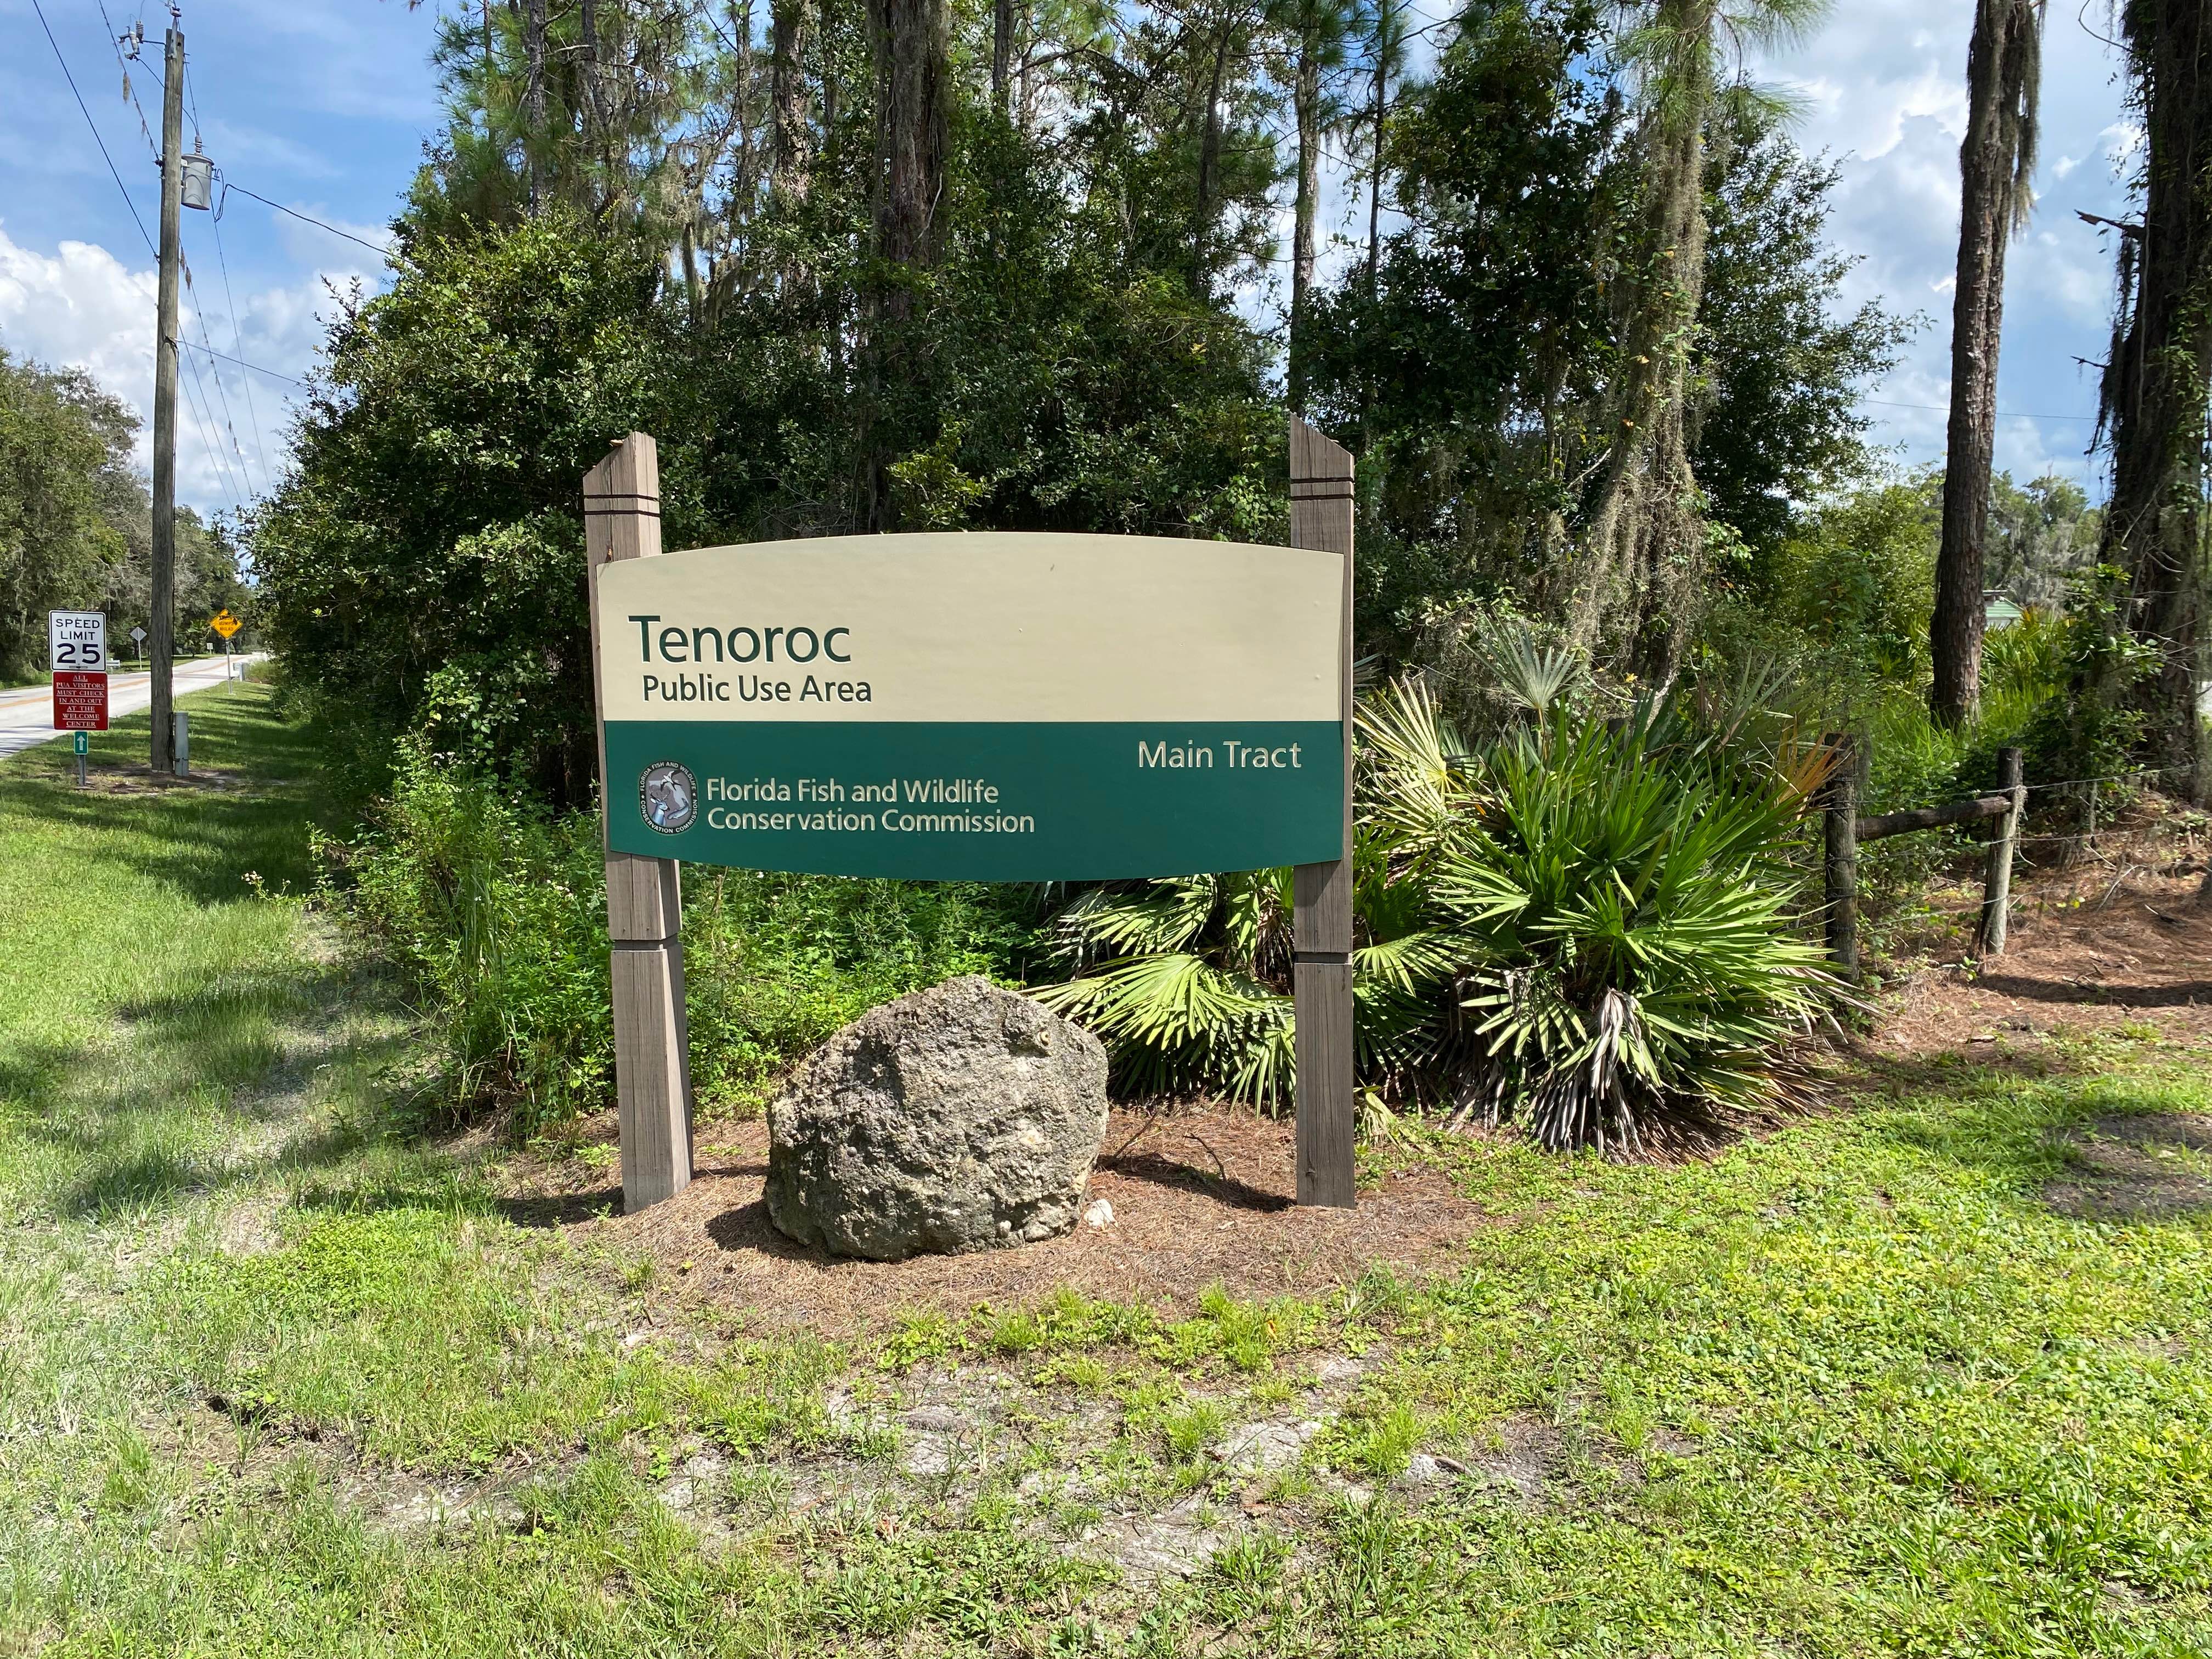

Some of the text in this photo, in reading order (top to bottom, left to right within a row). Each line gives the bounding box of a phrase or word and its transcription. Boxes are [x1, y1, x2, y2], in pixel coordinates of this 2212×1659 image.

[56, 619, 100, 629] SPEED
[60, 631, 95, 640] LIMIT
[628, 615, 851, 663] Tenoroc
[57, 643, 100, 664] 25
[642, 673, 872, 702] Public Use Area
[1138, 739, 1302, 768] Main Tract
[640, 768, 652, 791] FLORIDA
[651, 761, 664, 770] FISH
[680, 765, 696, 790] WILDLIFE
[707, 777, 999, 804] Florida Fish and Wildlife
[640, 799, 698, 833] CONSERVATION COMMISSION
[708, 807, 1035, 833] Conservation Commission
